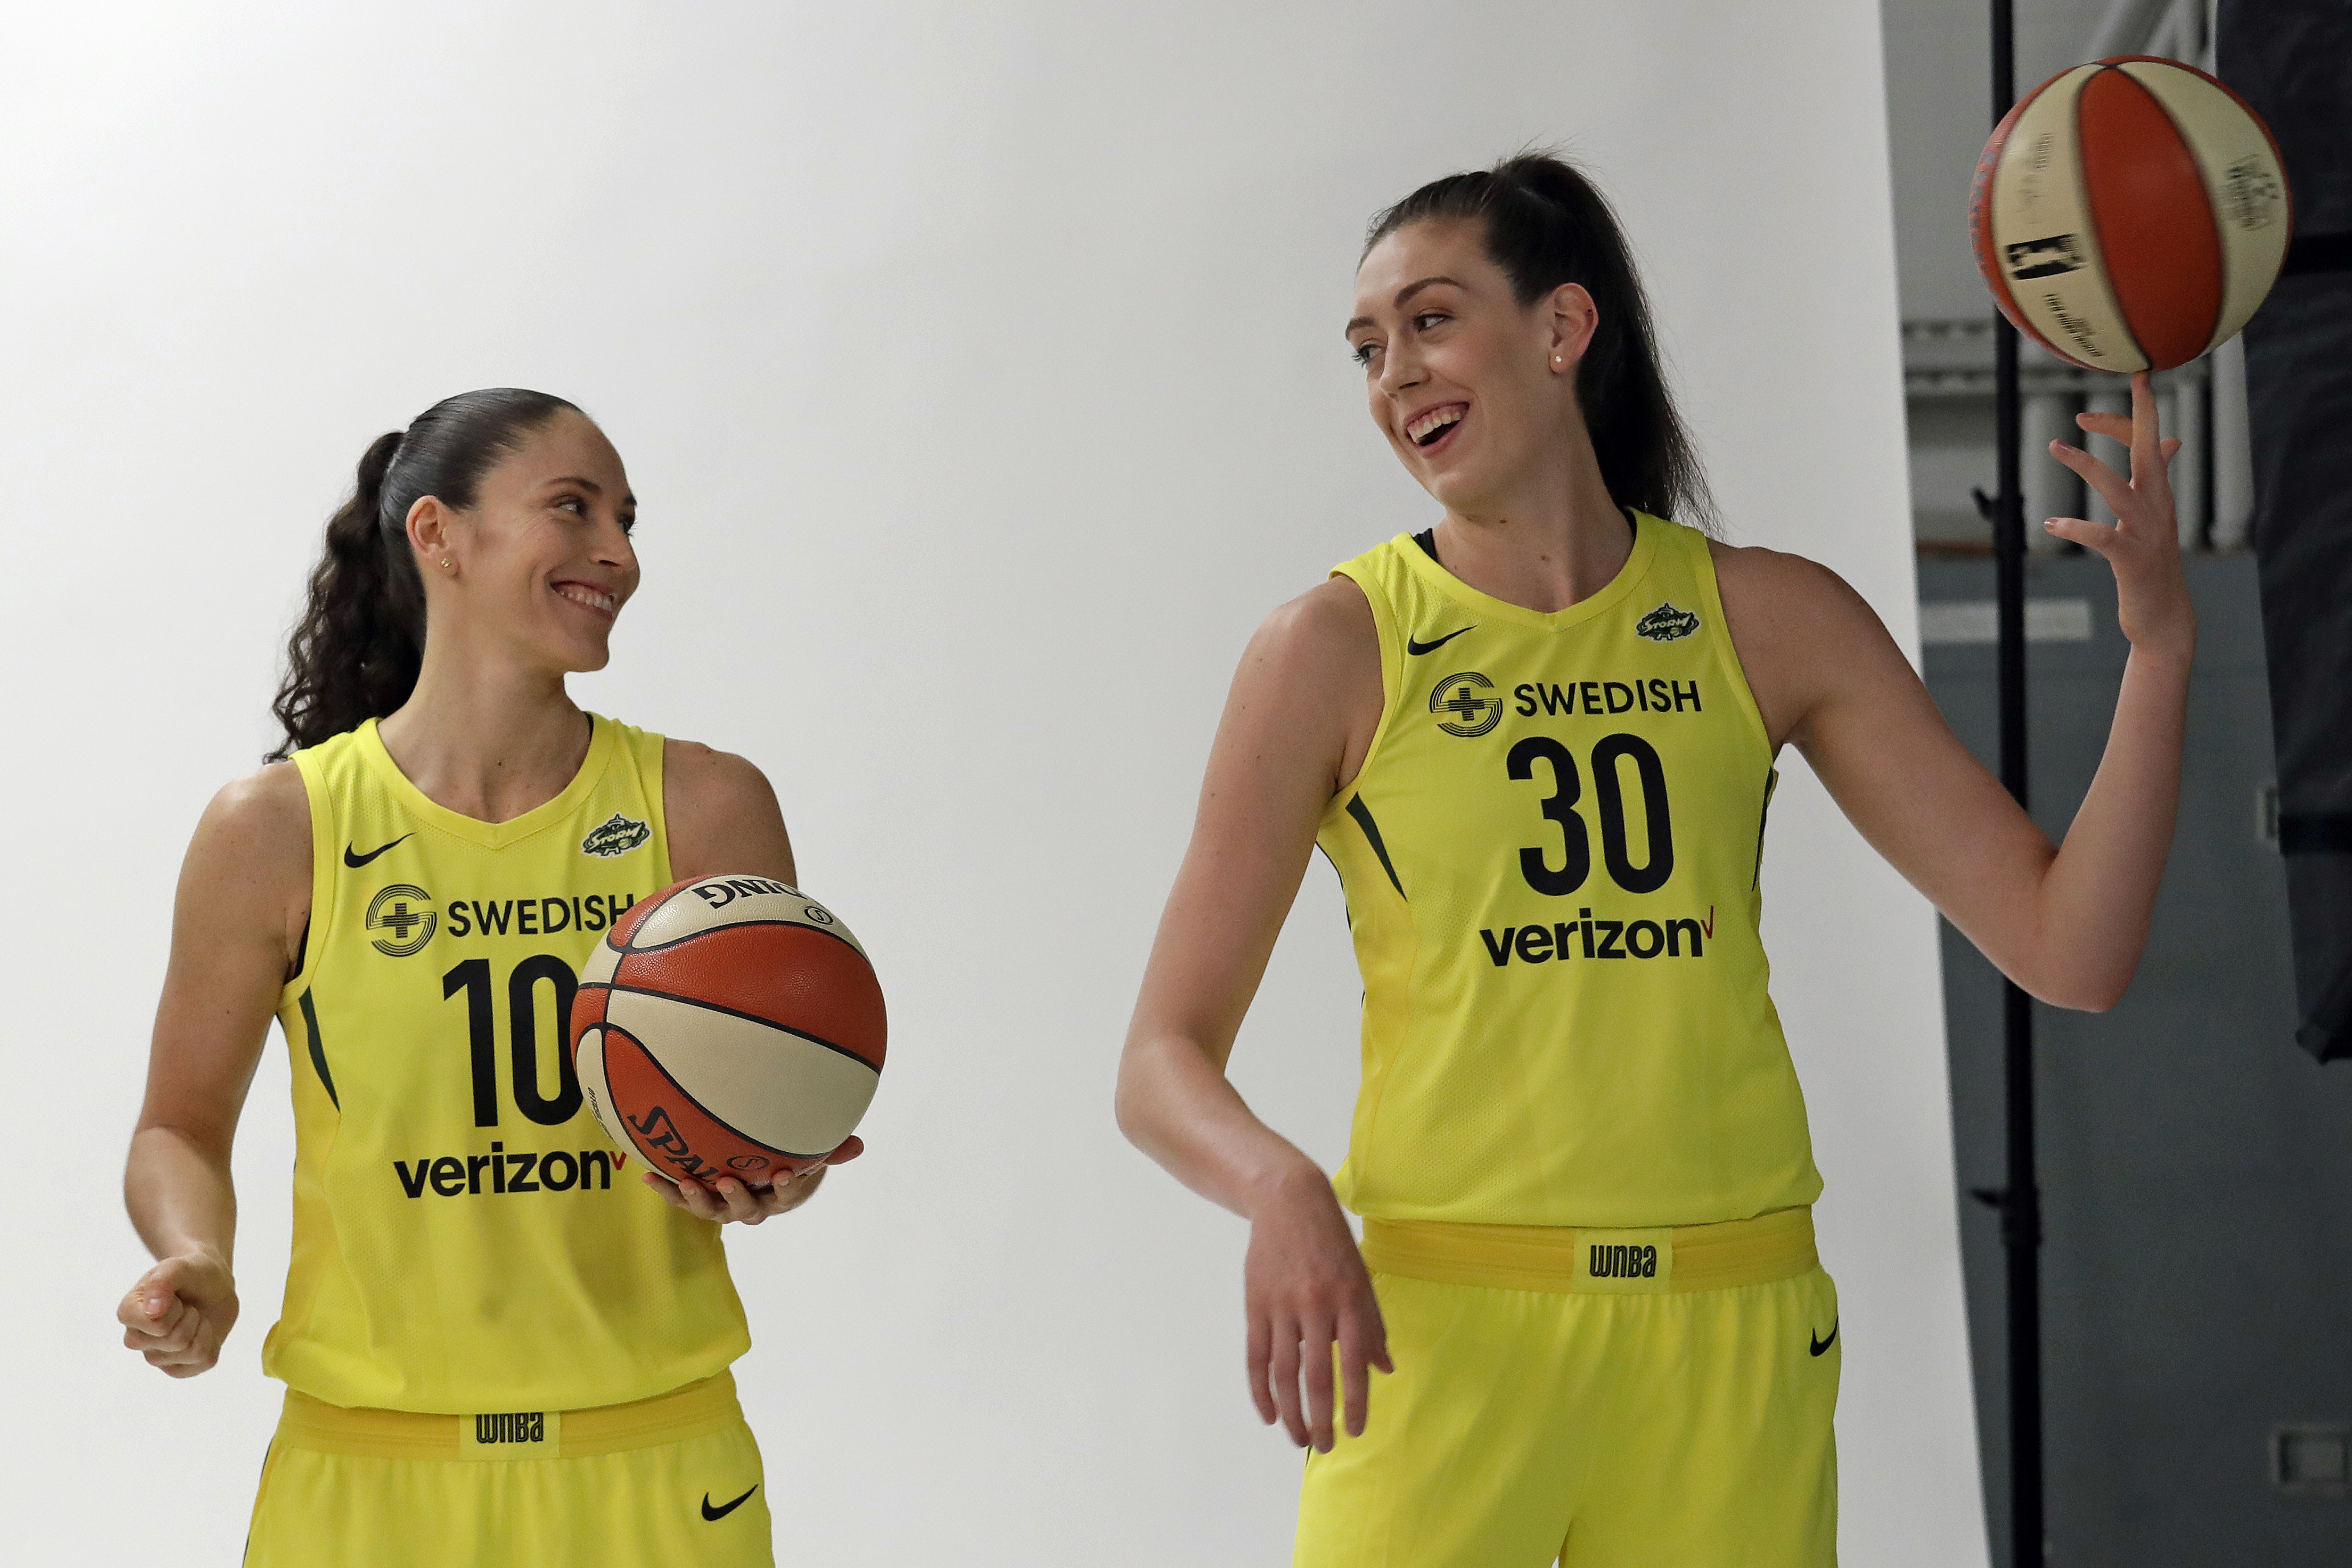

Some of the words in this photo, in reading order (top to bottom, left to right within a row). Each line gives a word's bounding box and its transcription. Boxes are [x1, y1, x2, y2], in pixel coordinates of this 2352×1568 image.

[1641, 615, 1691, 634] STORM
[1514, 678, 1702, 717] SWEDISH
[587, 823, 642, 851] STORM
[1506, 733, 1674, 896] 30
[448, 894, 634, 937] SWEDISH
[1480, 908, 1703, 967] verizon
[442, 954, 583, 1127] 10
[394, 1141, 610, 1198] verizon
